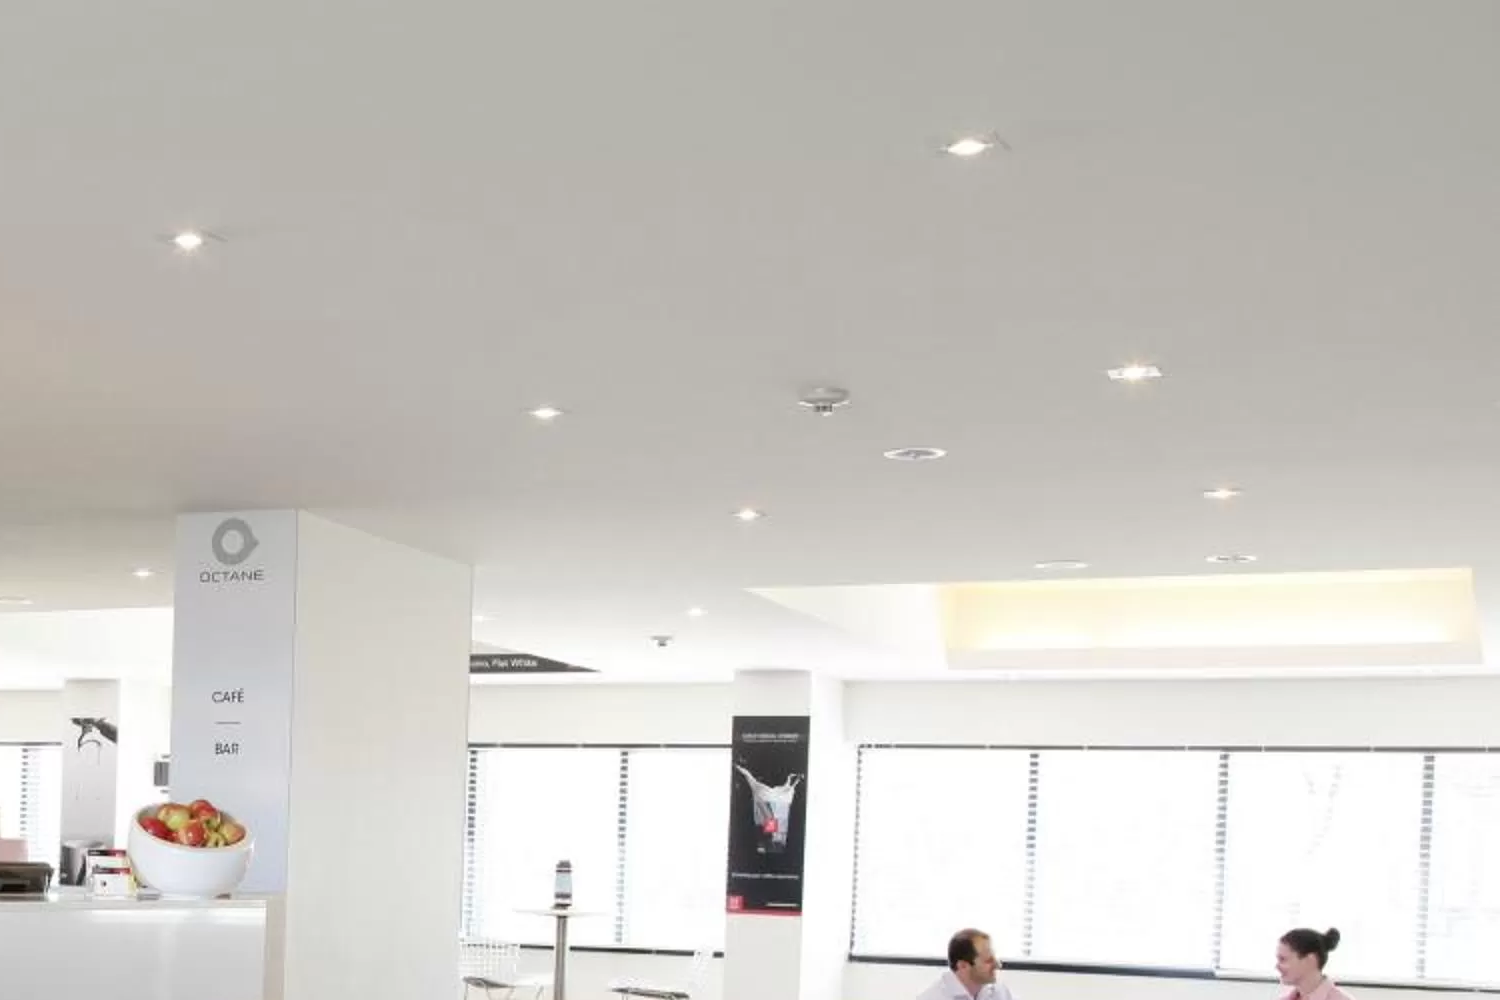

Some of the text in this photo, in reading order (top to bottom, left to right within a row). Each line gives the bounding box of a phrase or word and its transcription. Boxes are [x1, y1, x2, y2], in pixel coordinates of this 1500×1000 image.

[199, 569, 265, 583] OCTANE
[211, 687, 245, 703] CAFÉ
[215, 743, 240, 755] BAR
